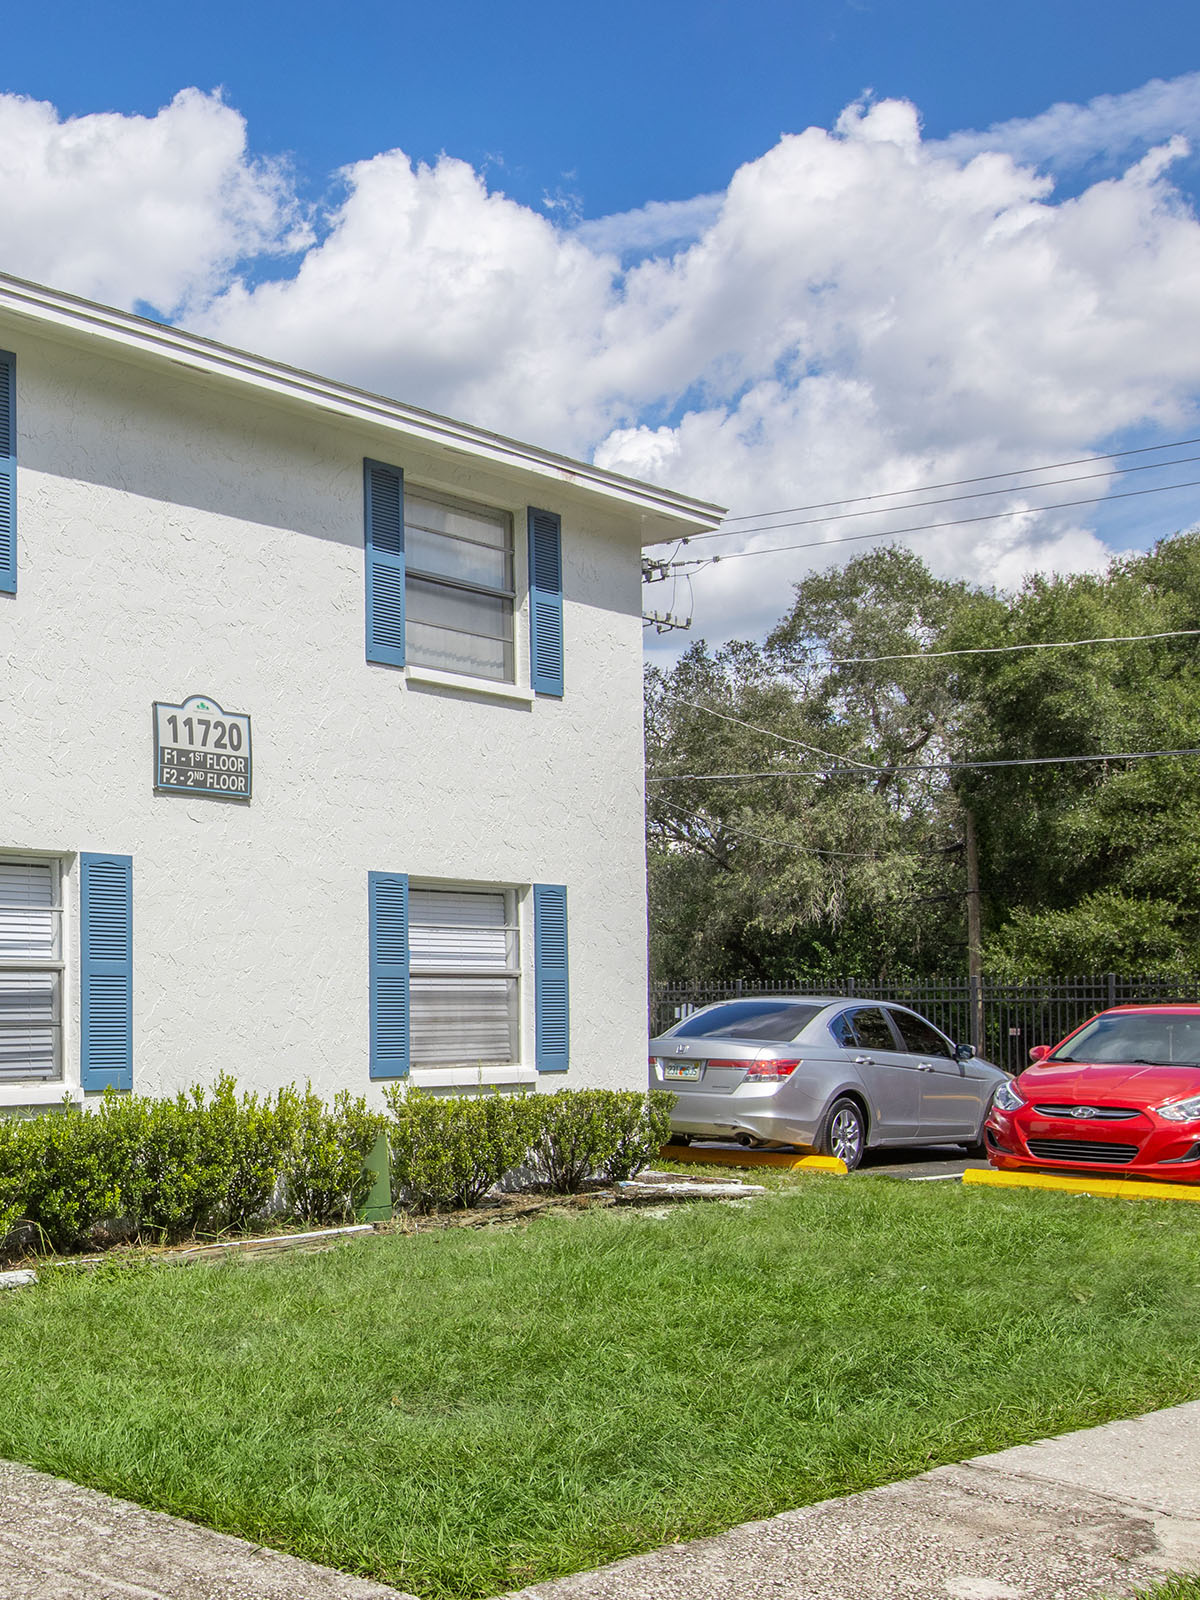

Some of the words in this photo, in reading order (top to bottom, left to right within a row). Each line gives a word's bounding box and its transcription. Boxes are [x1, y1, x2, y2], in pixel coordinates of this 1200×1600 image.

[167, 714, 242, 752] 11720
[164, 748, 177, 765] F1
[189, 751, 204, 767] 1ST
[206, 753, 245, 773] FLOOR
[163, 768, 177, 784] F2
[186, 771, 205, 786] 2ND
[206, 773, 246, 791] FLOOR
